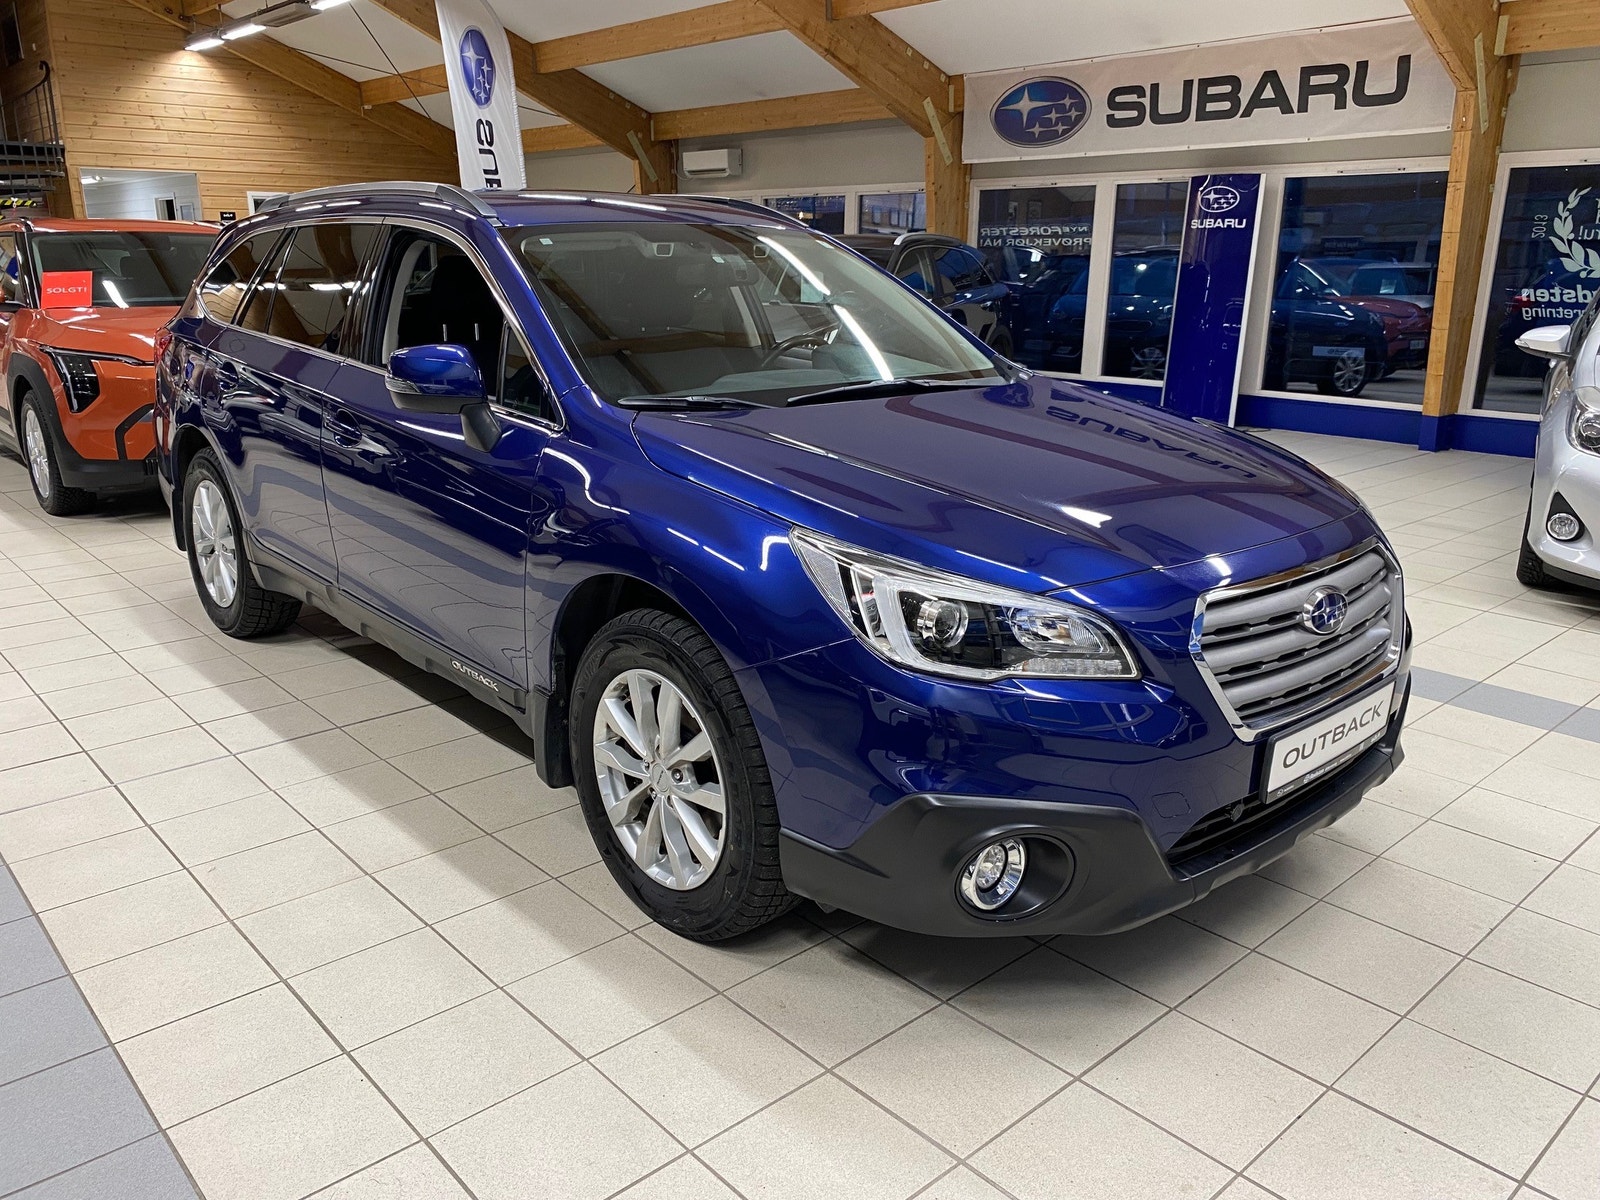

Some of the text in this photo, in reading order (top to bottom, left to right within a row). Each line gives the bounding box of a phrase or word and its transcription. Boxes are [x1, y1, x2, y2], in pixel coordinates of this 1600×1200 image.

[1106, 54, 1411, 128] SUBARU
[1191, 218, 1246, 228] SUBARU
[46, 286, 87, 294] SOLGT!
[451, 660, 499, 692] OUTBACK
[1282, 700, 1384, 769] OUTBACK
